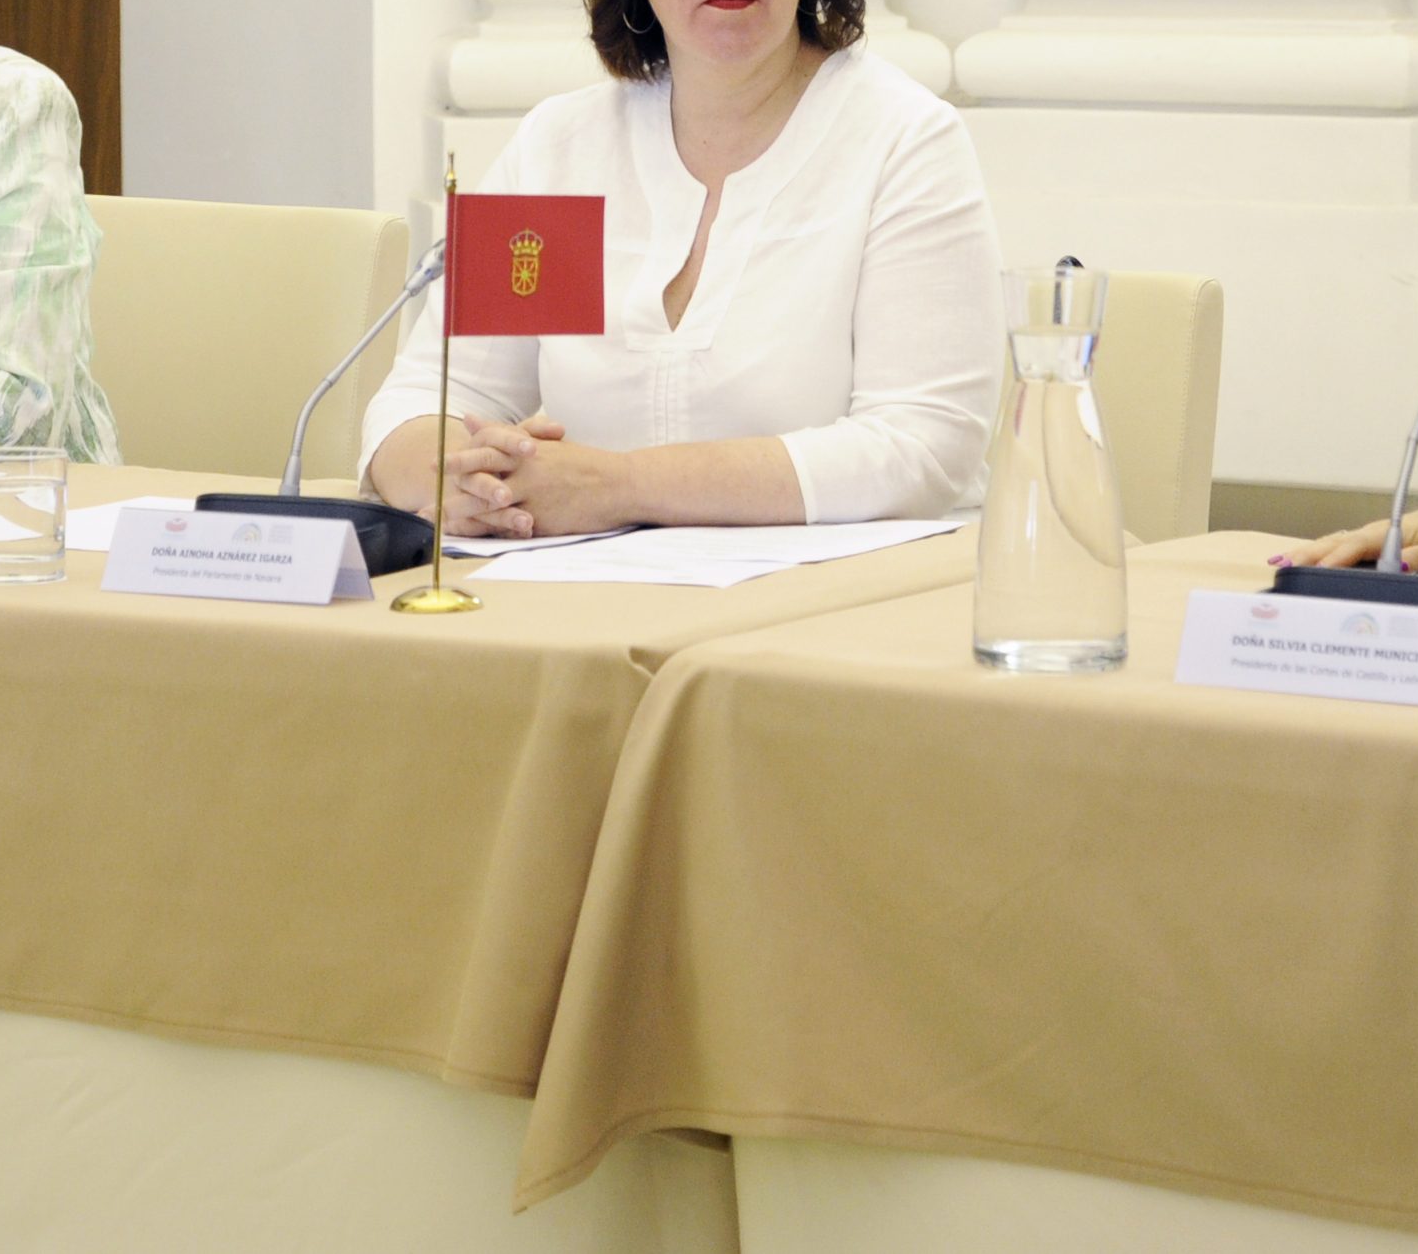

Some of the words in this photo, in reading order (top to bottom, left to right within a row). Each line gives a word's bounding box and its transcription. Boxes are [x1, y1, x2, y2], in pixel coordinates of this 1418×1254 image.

[151, 546, 177, 557] DOÑA
[216, 549, 257, 563] AZNÁREZ
[259, 553, 292, 565] IGARZA
[1232, 634, 1265, 648] DOÑA
[1268, 639, 1307, 652] SILVIA
[1311, 643, 1369, 659] CLEMENTE
